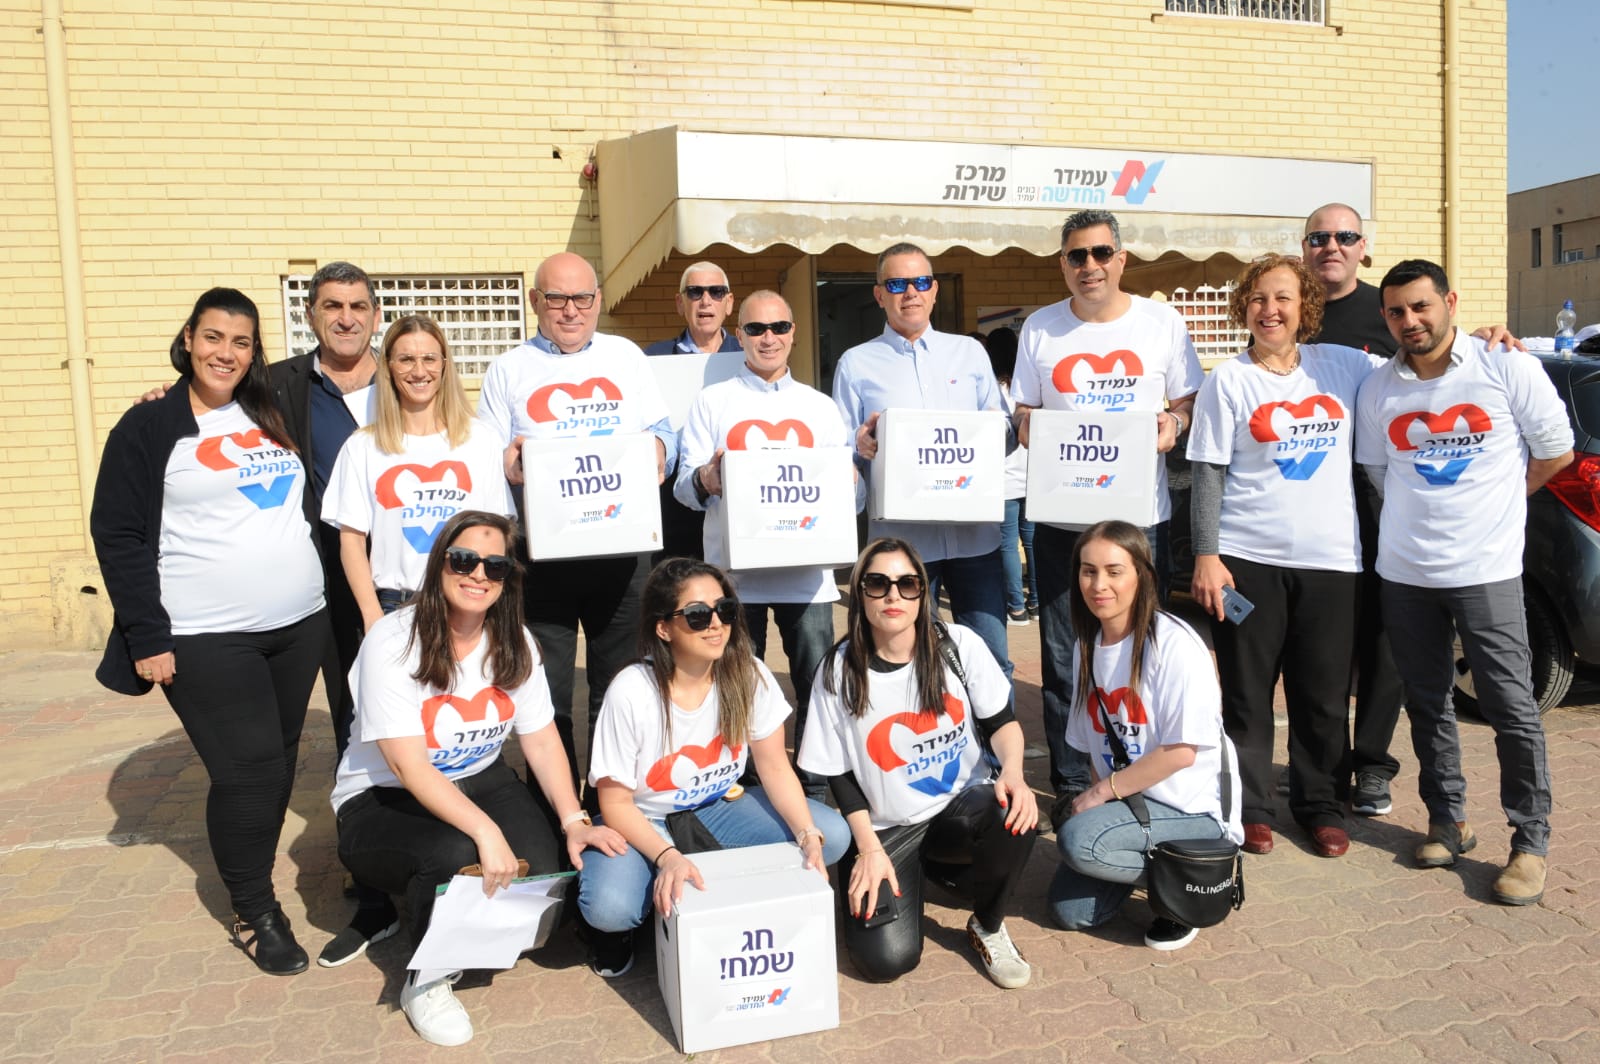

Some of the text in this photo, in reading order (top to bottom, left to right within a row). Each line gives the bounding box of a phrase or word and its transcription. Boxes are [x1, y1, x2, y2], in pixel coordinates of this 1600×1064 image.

[955, 164, 1006, 181] מרכז
[1053, 169, 1108, 187] עמידר
[942, 185, 1006, 202] שירות
[1041, 185, 1106, 204] החדשה
[1087, 377, 1137, 389] עמידר
[1075, 392, 1135, 406] בקהילה
[566, 402, 619, 415] עמידר
[556, 415, 621, 430] בקהילה
[1289, 421, 1340, 435] עמידר
[933, 428, 958, 445] חג
[1077, 424, 1103, 442] חג
[1425, 434, 1485, 446] עמידר
[1059, 443, 1119, 462] שמח!
[1277, 436, 1336, 451] בקהילה
[575, 454, 602, 475] חג
[918, 447, 975, 465] שמח!
[239, 460, 301, 478] בקהילה
[777, 464, 803, 482] חג
[560, 472, 622, 498] שמח!
[760, 485, 821, 503] שמח!
[413, 489, 466, 501] עמידר
[402, 504, 462, 519] קהילה
[454, 722, 507, 743] עמידר
[912, 721, 965, 753] עמידר
[907, 736, 968, 775] בקהילה
[741, 928, 774, 952] חג
[720, 951, 794, 980] שמח!
[741, 995, 765, 1003] עמידר
